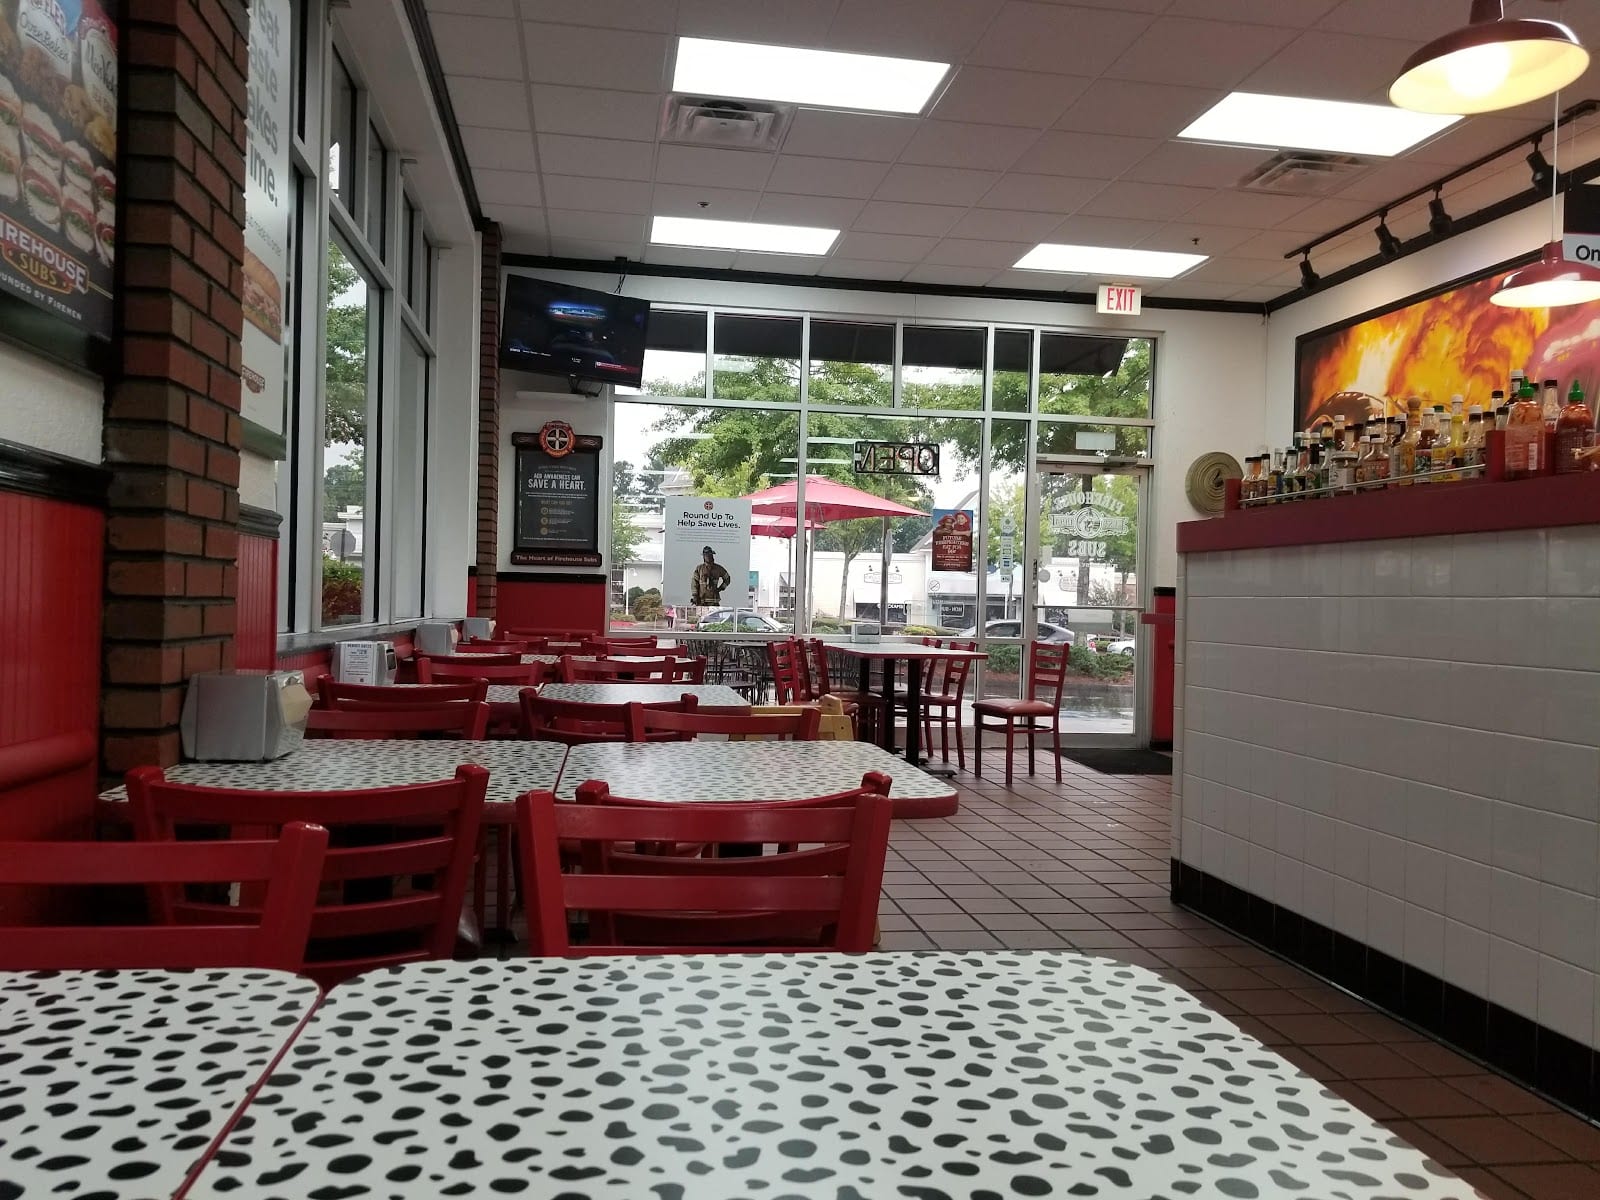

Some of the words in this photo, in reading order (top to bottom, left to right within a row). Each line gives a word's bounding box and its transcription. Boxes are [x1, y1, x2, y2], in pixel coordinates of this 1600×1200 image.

[20, 252, 58, 286] SUBS
[0, 271, 32, 294] UNDED
[33, 289, 46, 301] BY
[48, 295, 82, 320] FIREMEN
[1107, 287, 1136, 311] EXIT
[528, 478, 549, 489] SAVE
[551, 480, 557, 489] A
[559, 480, 586, 490] HEART.
[683, 511, 710, 519] Round
[711, 512, 723, 520] Up
[697, 520, 717, 528] Save
[718, 520, 741, 529] Lives.
